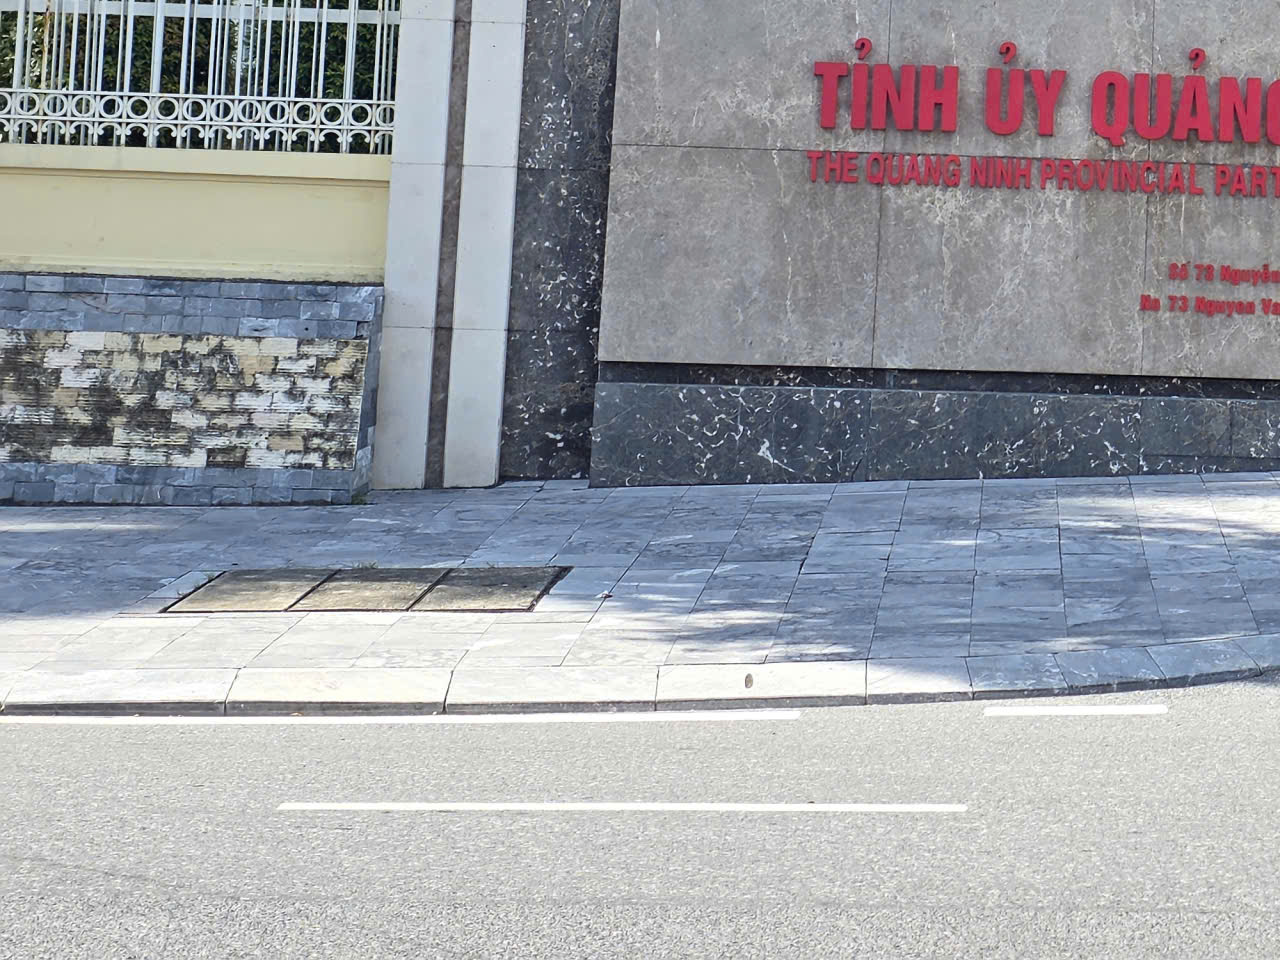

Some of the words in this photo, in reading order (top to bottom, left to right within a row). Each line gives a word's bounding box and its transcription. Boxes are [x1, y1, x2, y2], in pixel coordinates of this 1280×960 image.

[813, 36, 960, 134] TỈNH
[984, 40, 1068, 137] ỦY
[806, 150, 859, 184] THE
[866, 151, 962, 188] QUANG
[969, 155, 1032, 189] NINH
[1040, 158, 1205, 196] PROVINCIAL
[1168, 260, 1191, 281] Số
[1194, 263, 1215, 281] 73
[1140, 294, 1161, 312] No
[1168, 295, 1189, 313] 73
[1195, 296, 1256, 318] Nguyen
